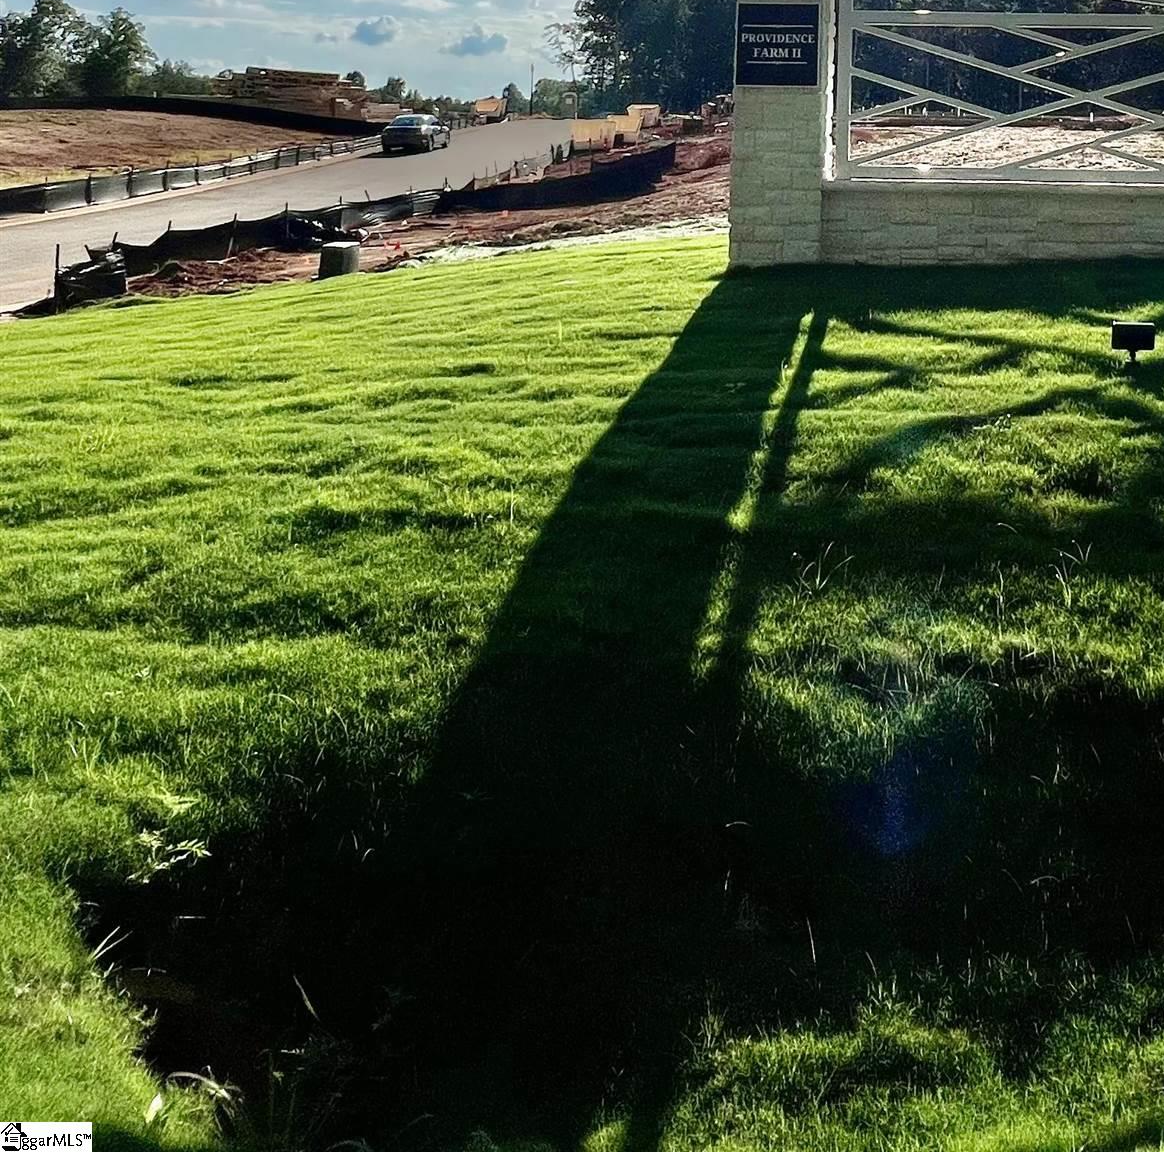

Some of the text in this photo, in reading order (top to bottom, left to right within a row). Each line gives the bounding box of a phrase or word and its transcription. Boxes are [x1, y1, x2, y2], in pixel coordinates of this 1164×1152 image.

[741, 33, 815, 44] PROVIDENCE
[752, 47, 802, 58] FARM II
